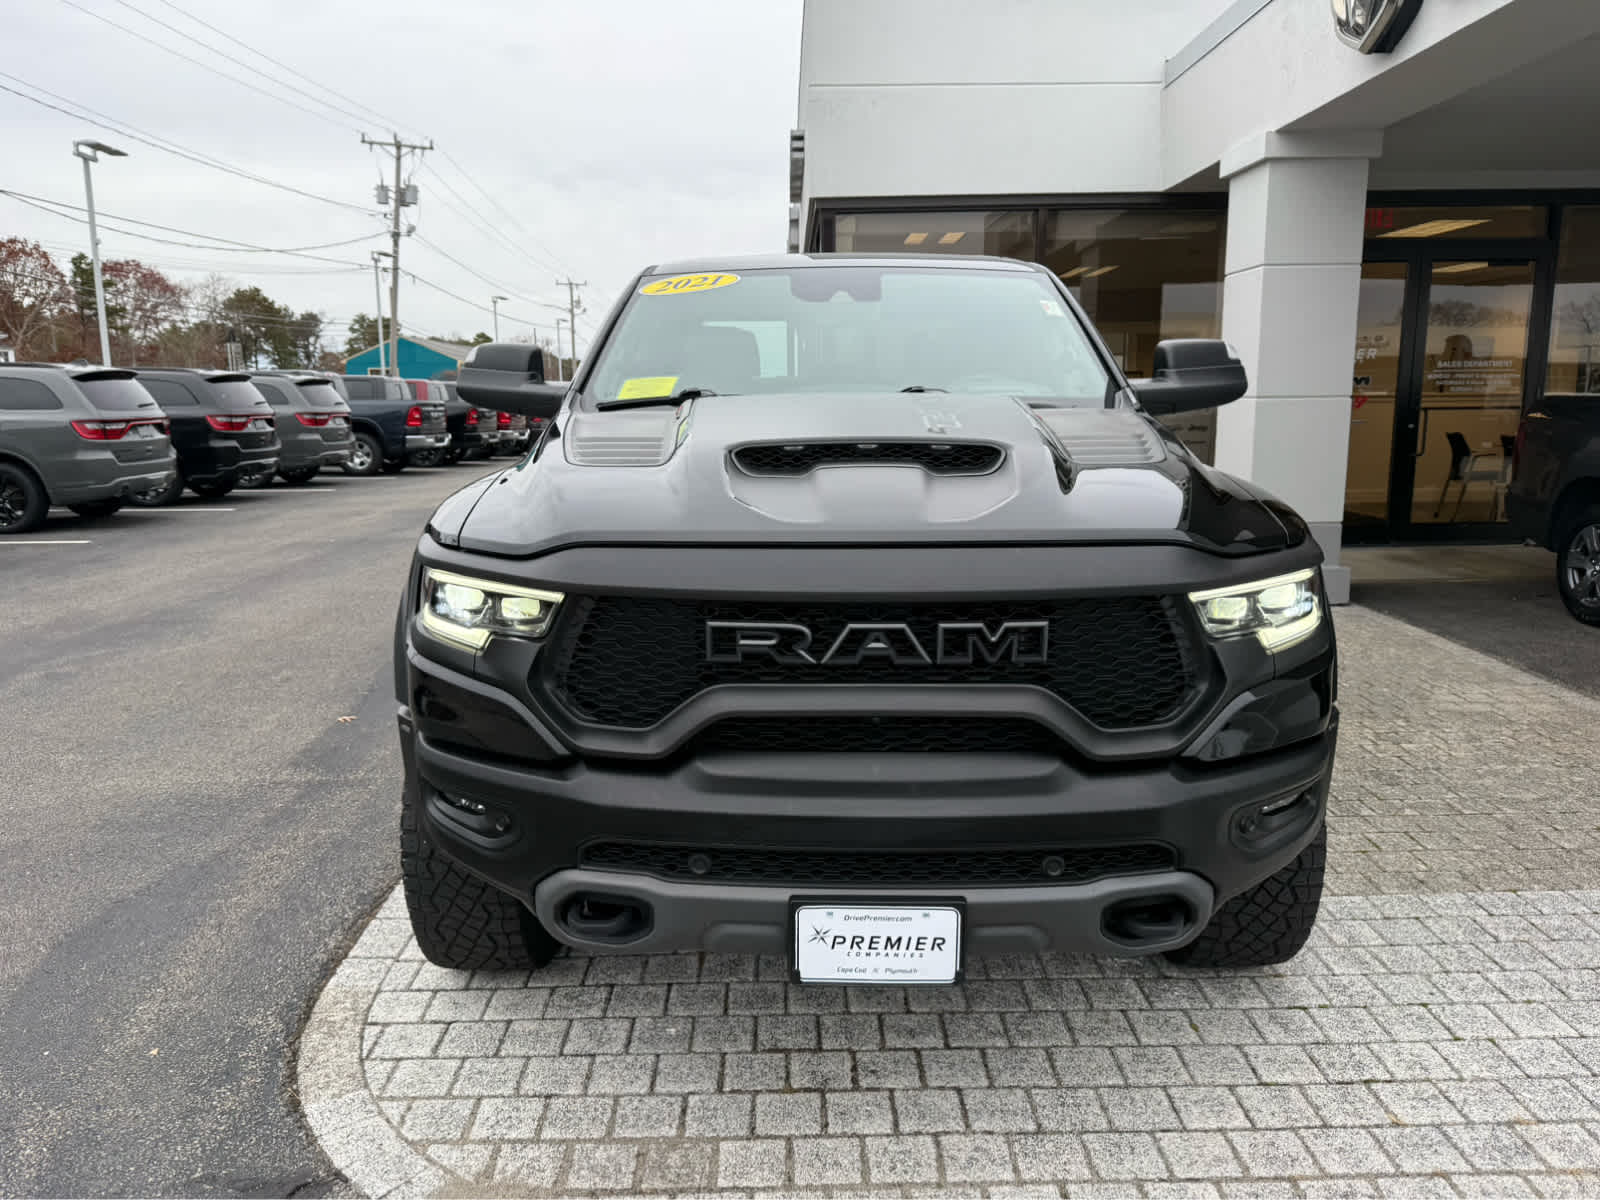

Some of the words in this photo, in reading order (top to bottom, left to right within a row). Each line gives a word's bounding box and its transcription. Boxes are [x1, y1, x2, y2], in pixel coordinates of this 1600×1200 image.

[655, 275, 723, 292] 2021
[705, 620, 1050, 665] RAM
[844, 914, 913, 923] DrivePremier.com
[831, 935, 946, 952] PREMIER
[836, 966, 853, 975] Cape
[854, 966, 867, 975] Cod
[885, 966, 918, 976] Plymouth
